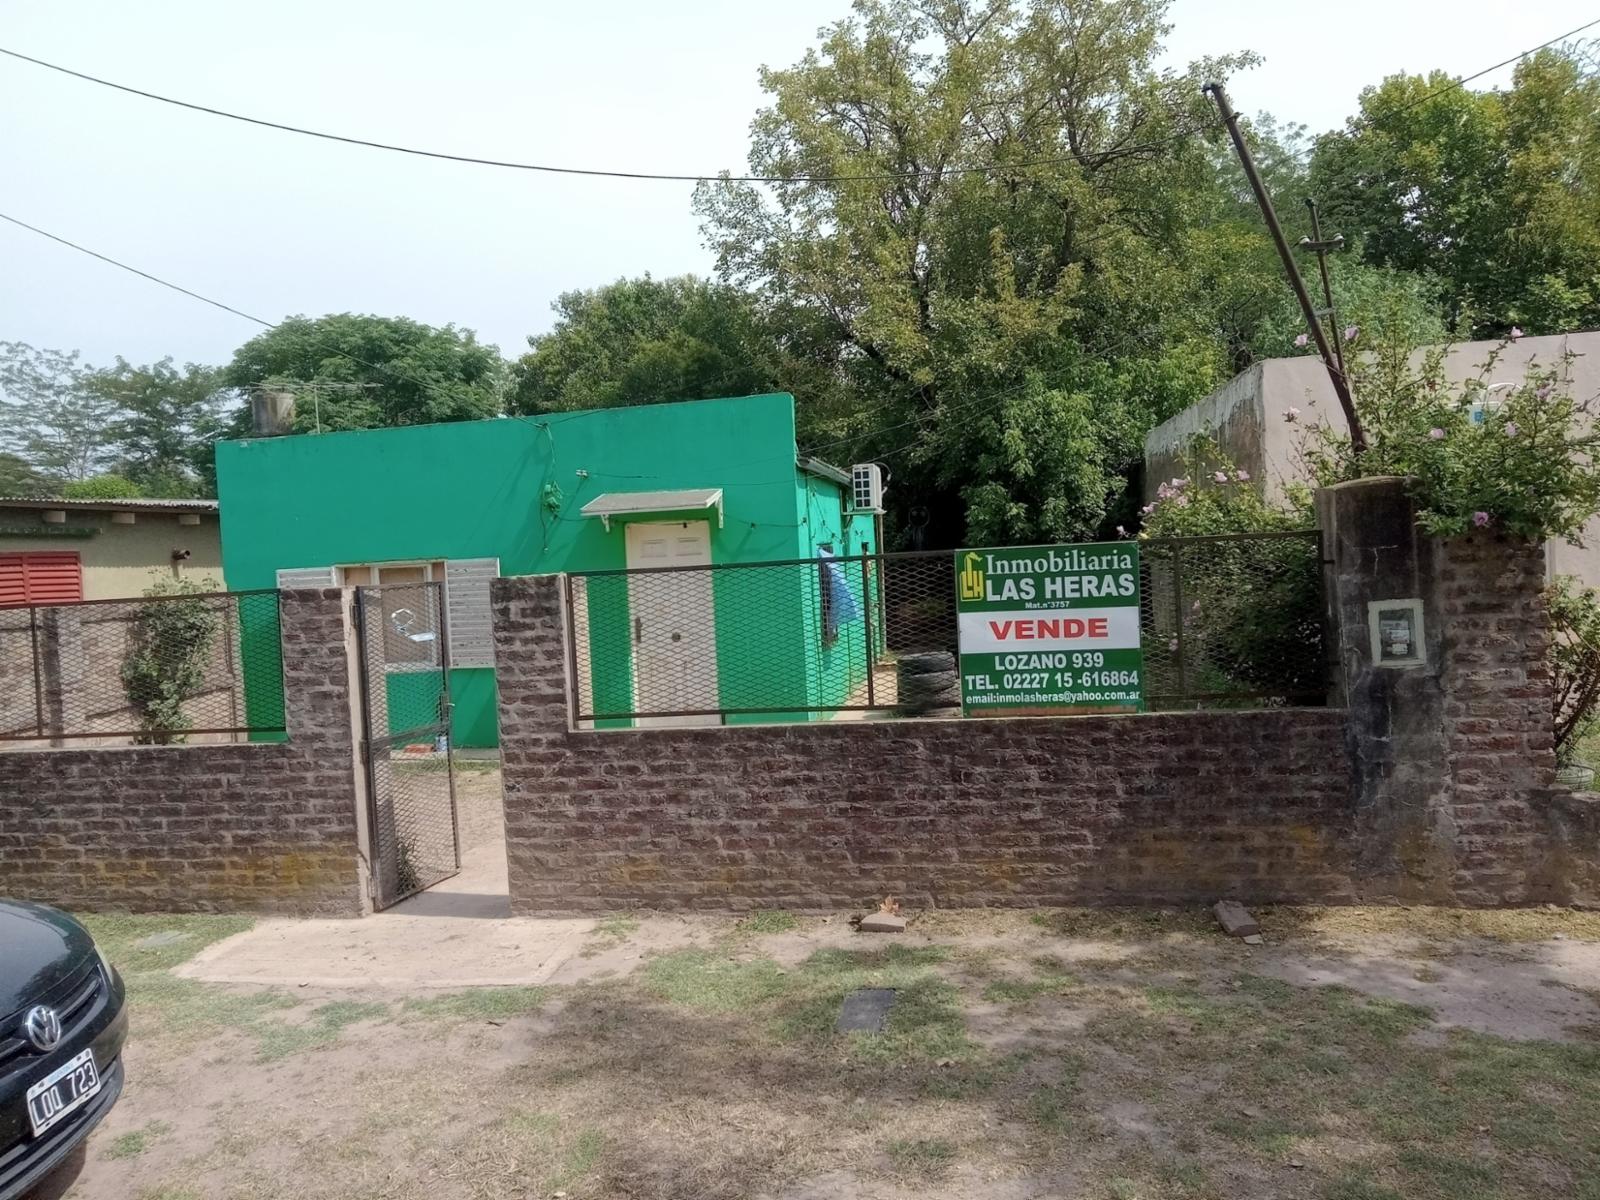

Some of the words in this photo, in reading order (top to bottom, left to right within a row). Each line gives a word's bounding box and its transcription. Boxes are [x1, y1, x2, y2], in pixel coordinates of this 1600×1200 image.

[985, 550, 1133, 574] Inmobiliaria
[986, 578, 1036, 601] LAS
[1045, 573, 1135, 599] HERAS
[989, 618, 1108, 640] VENDE
[995, 654, 1067, 670] LOZANO
[1072, 652, 1104, 668] 939
[965, 675, 999, 690] TEL.
[1004, 673, 1049, 689] 02227
[1054, 673, 1073, 687] 15
[1078, 671, 1139, 687] -616864
[966, 691, 1141, 704] email:inmolasheras@yahoo.com.ar
[67, 1062, 96, 1098] 723
